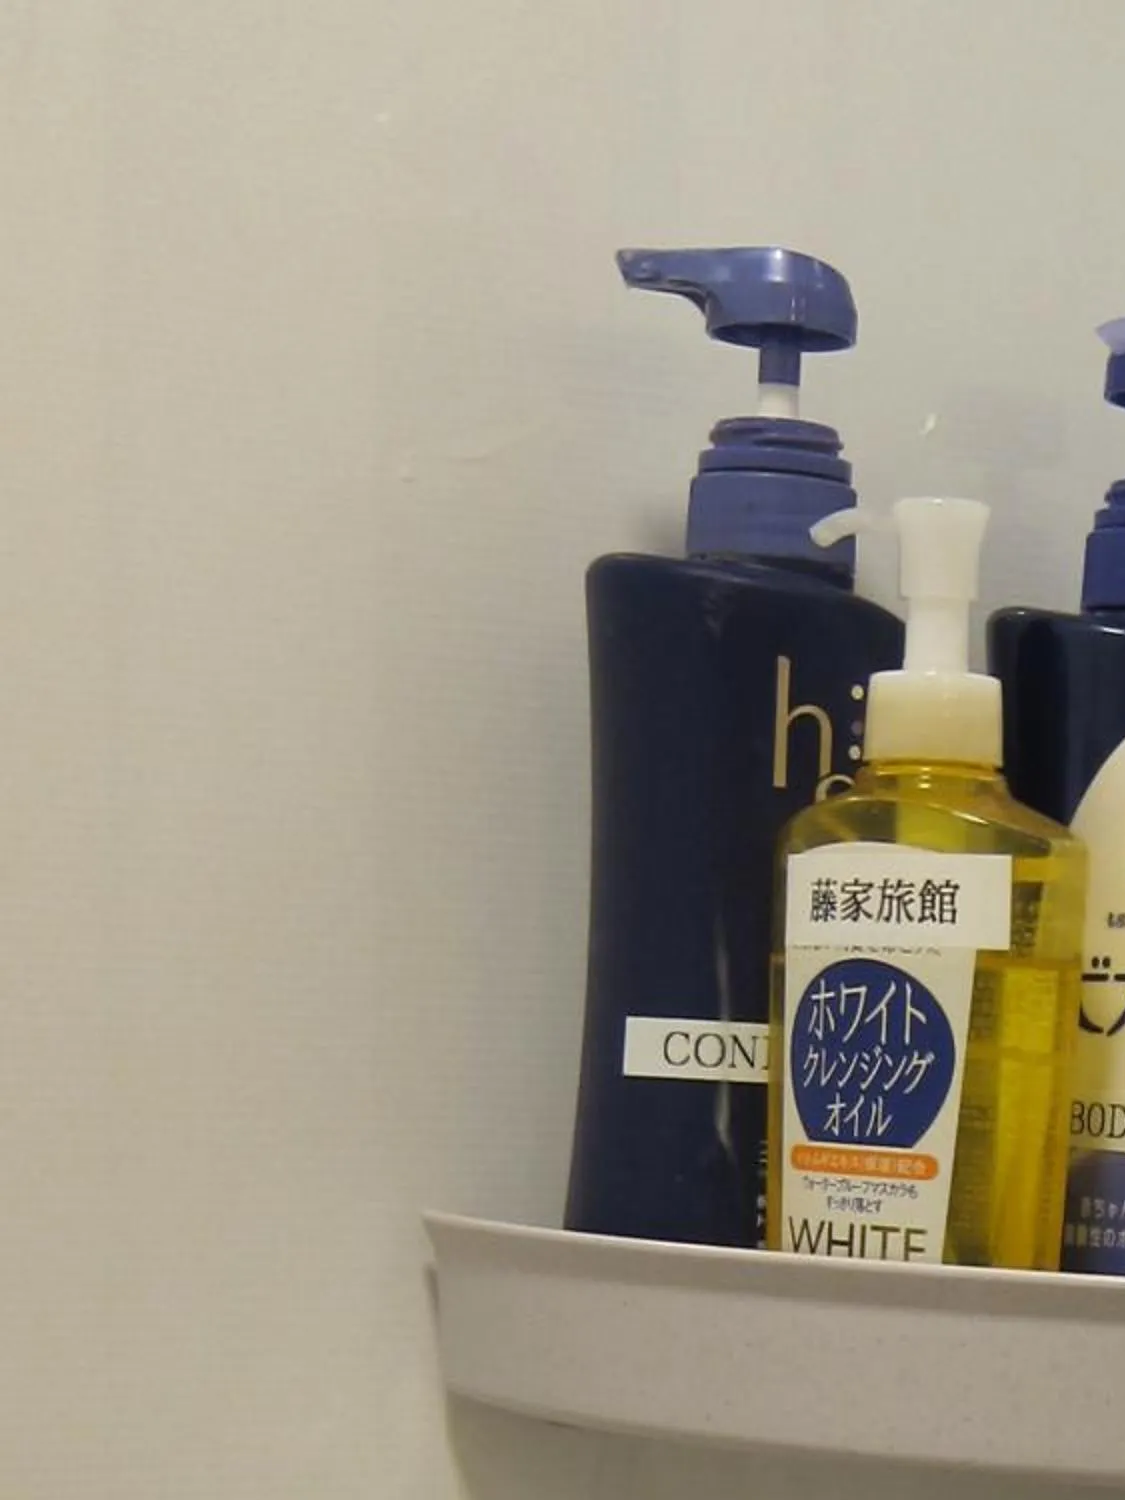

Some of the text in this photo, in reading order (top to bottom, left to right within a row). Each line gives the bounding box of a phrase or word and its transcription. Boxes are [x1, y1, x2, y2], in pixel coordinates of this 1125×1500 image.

[810, 877, 960, 925] 藤家旅館
[808, 979, 927, 1046] ホワイト
[804, 1045, 936, 1095] クレンジング
[824, 1092, 893, 1137] オイル
[789, 1215, 928, 1262] WHITE
